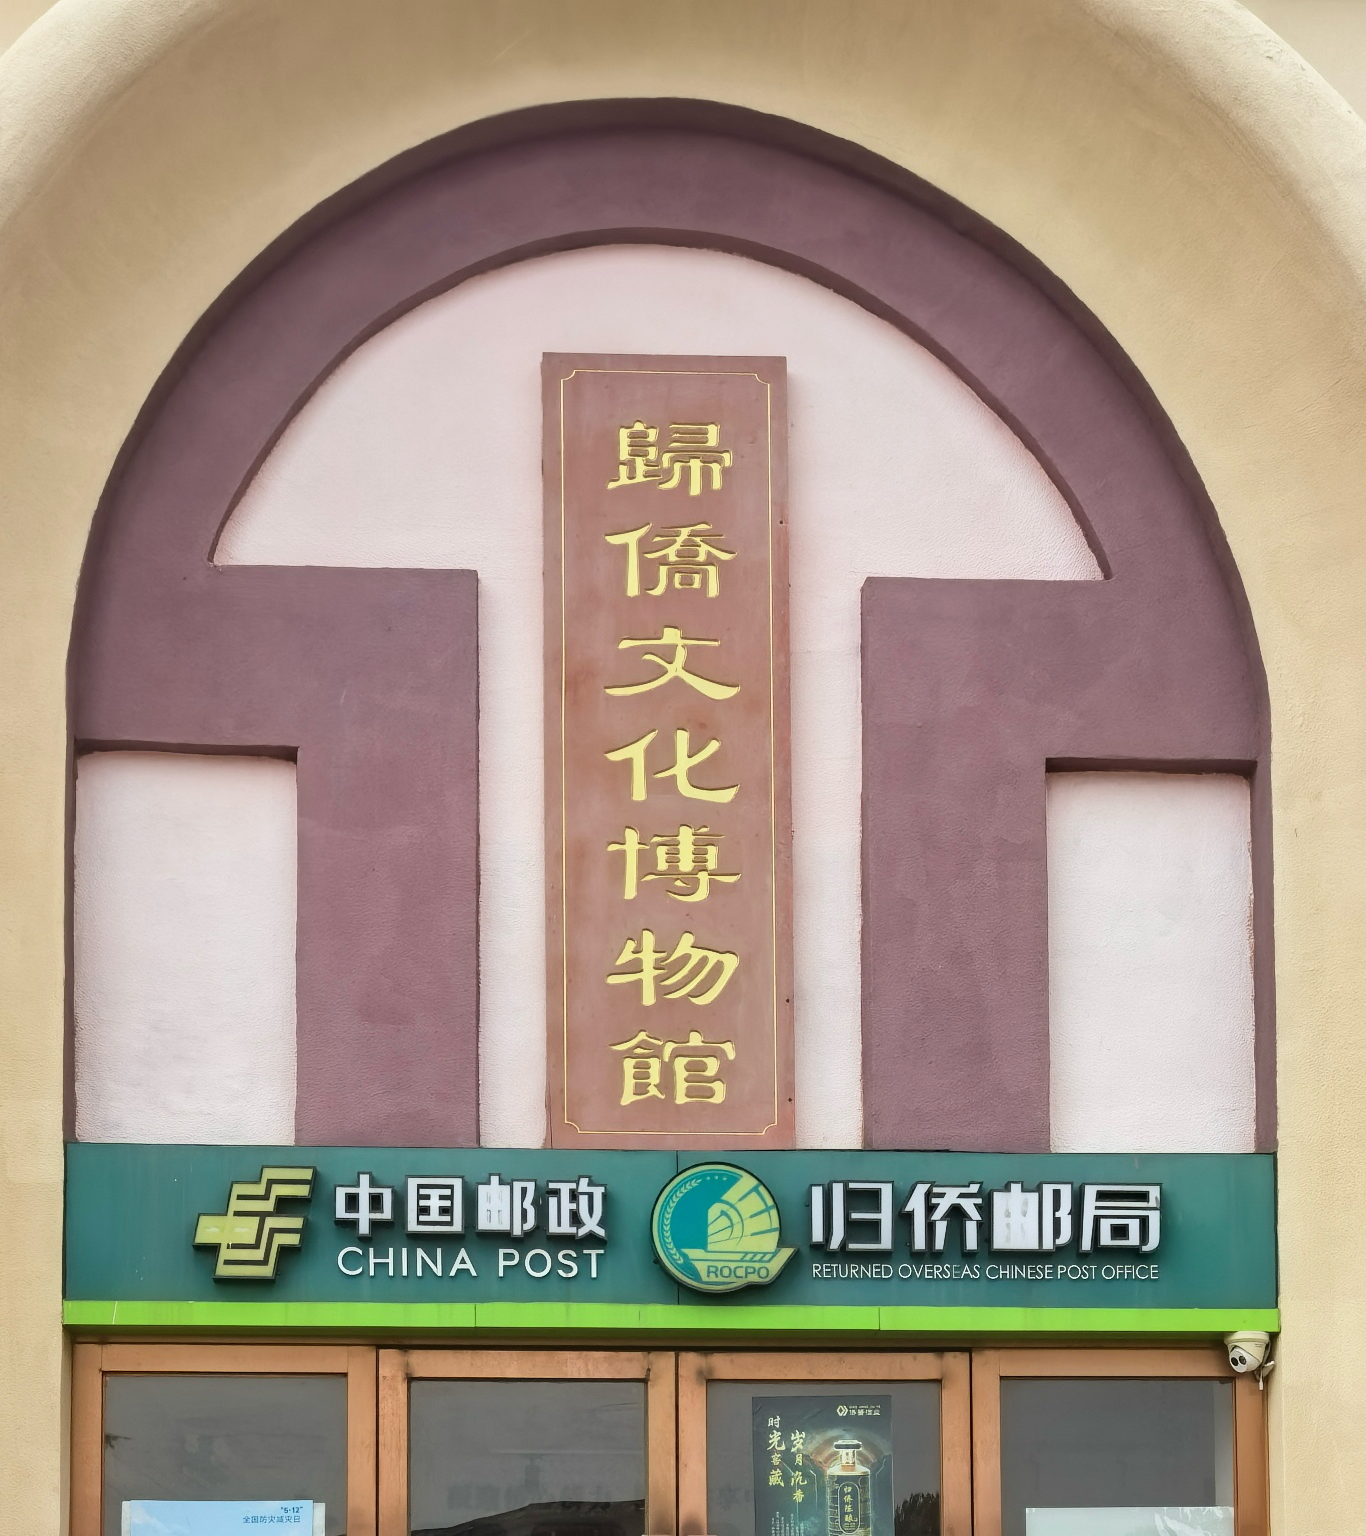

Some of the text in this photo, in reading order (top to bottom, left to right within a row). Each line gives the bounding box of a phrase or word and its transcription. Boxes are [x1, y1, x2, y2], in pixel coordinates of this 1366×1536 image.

[604, 418, 742, 1109] 歸僑文化博物館
[334, 1172, 609, 1238] 中国邮政
[809, 1180, 1163, 1254] 归侨邮局
[337, 1246, 608, 1279] CHINA POST
[706, 1265, 770, 1280] ROCPO
[812, 1263, 1159, 1280] RETURNED OVERSEAS CHINESE POST OFFICE
